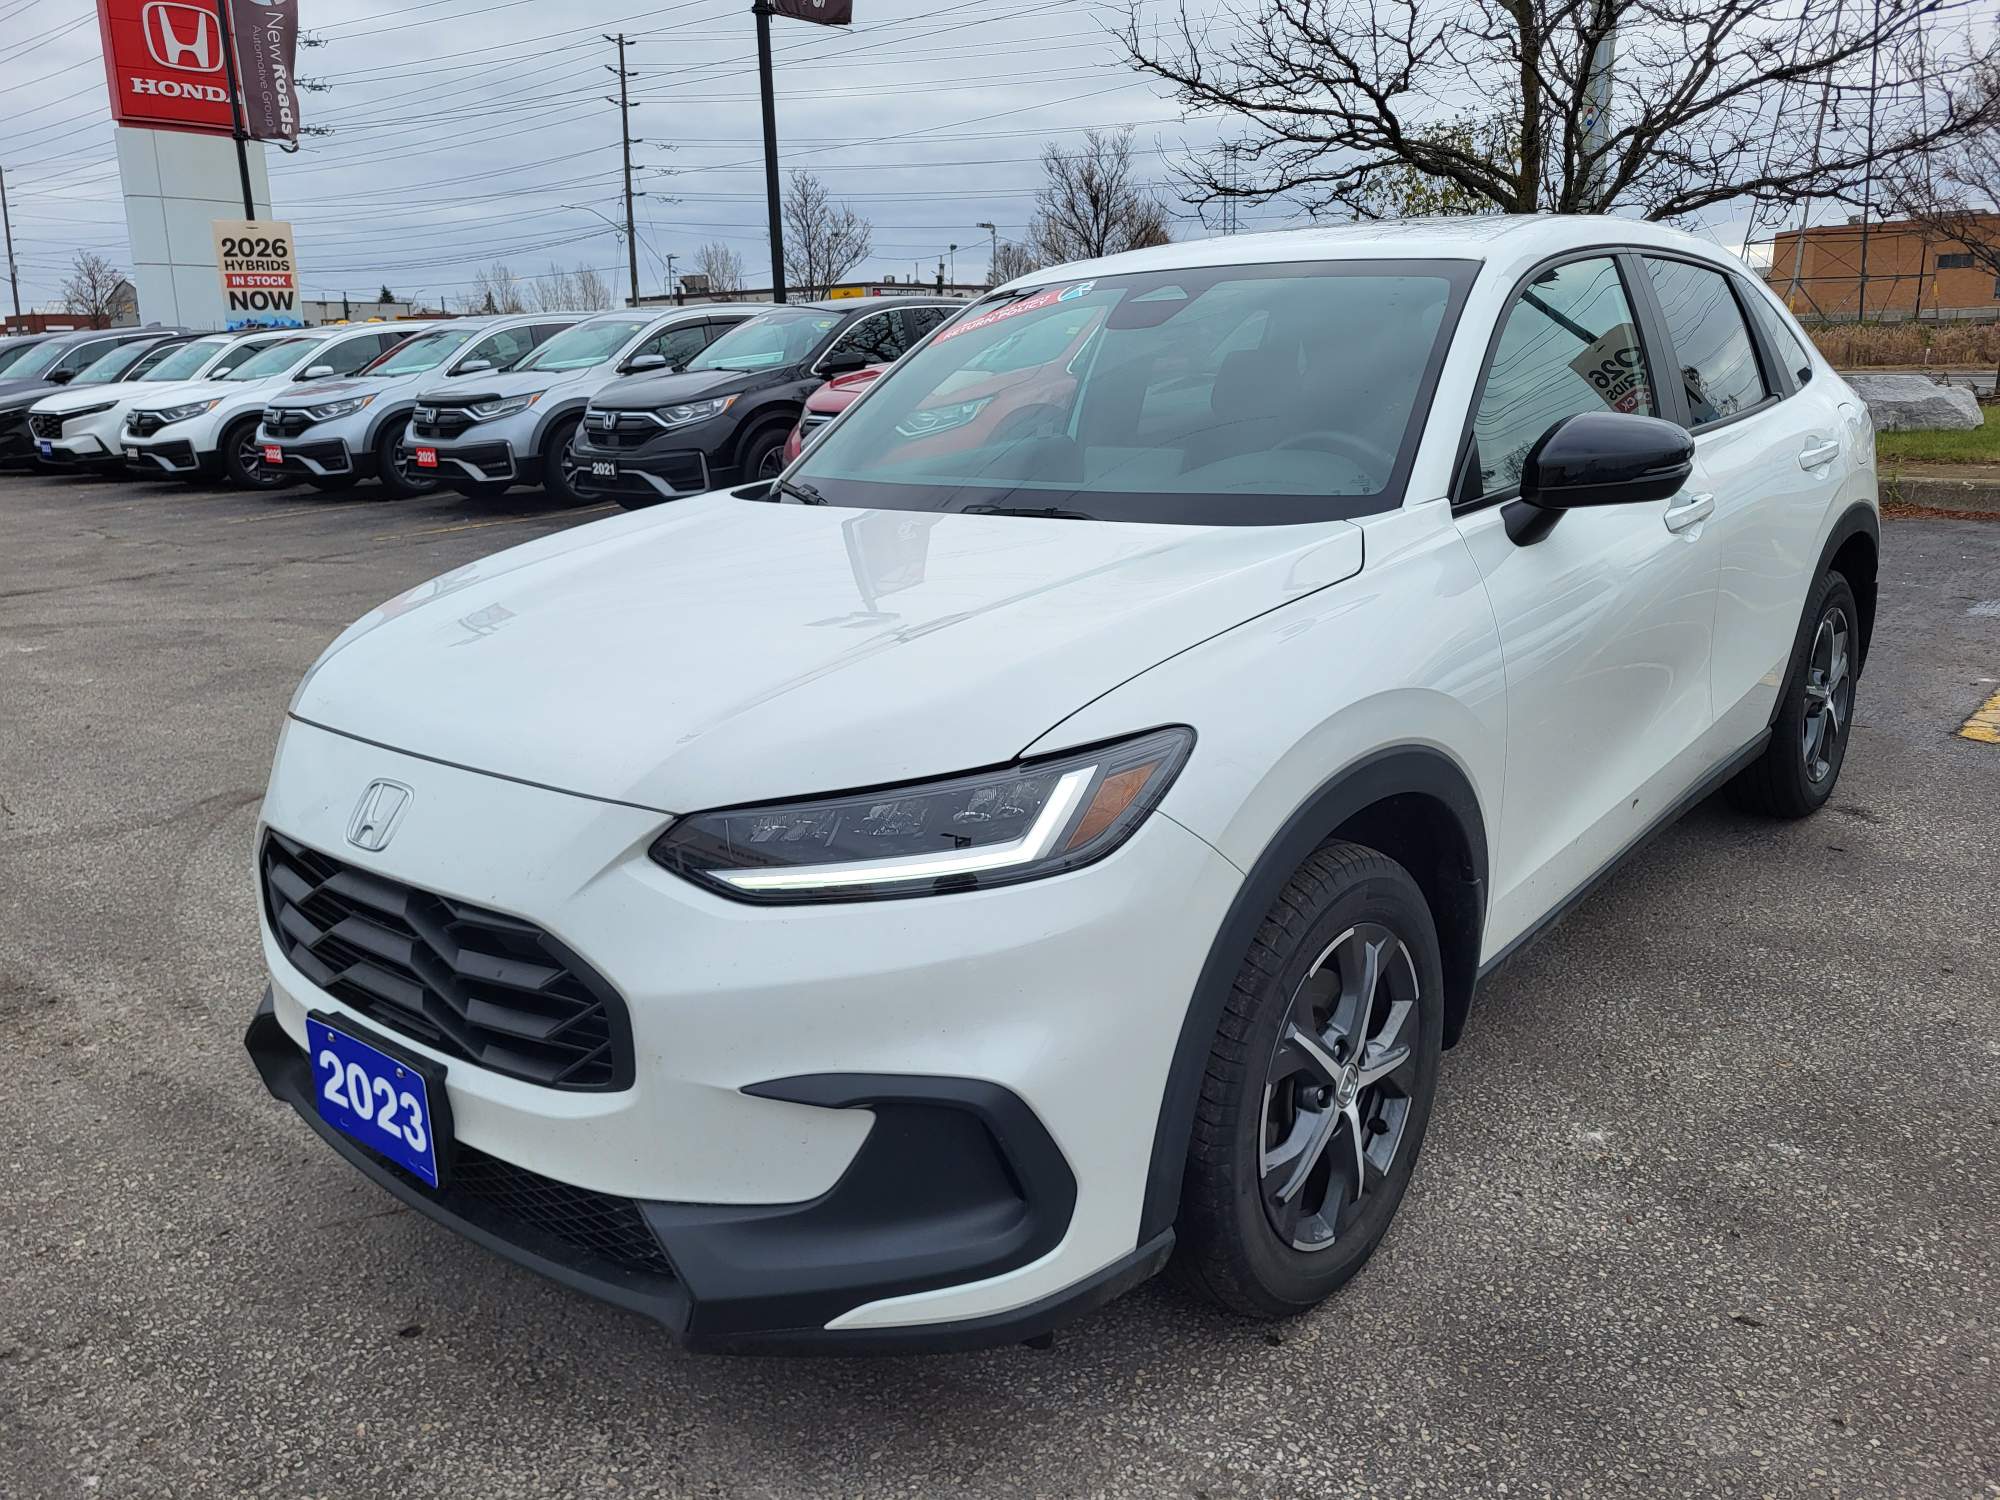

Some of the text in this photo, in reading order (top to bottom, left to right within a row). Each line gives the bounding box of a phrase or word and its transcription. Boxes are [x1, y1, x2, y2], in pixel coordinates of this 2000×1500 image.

[252, 25, 273, 127] Automotive Group
[222, 237, 288, 258] 2026
[224, 260, 290, 271] HYBRIDS
[232, 276, 286, 286] IN STOCK
[229, 291, 294, 311] NOW
[998, 294, 1051, 319] POLICY
[417, 450, 436, 463] 2021
[592, 462, 615, 476] 2021
[319, 1049, 427, 1153] 2023
